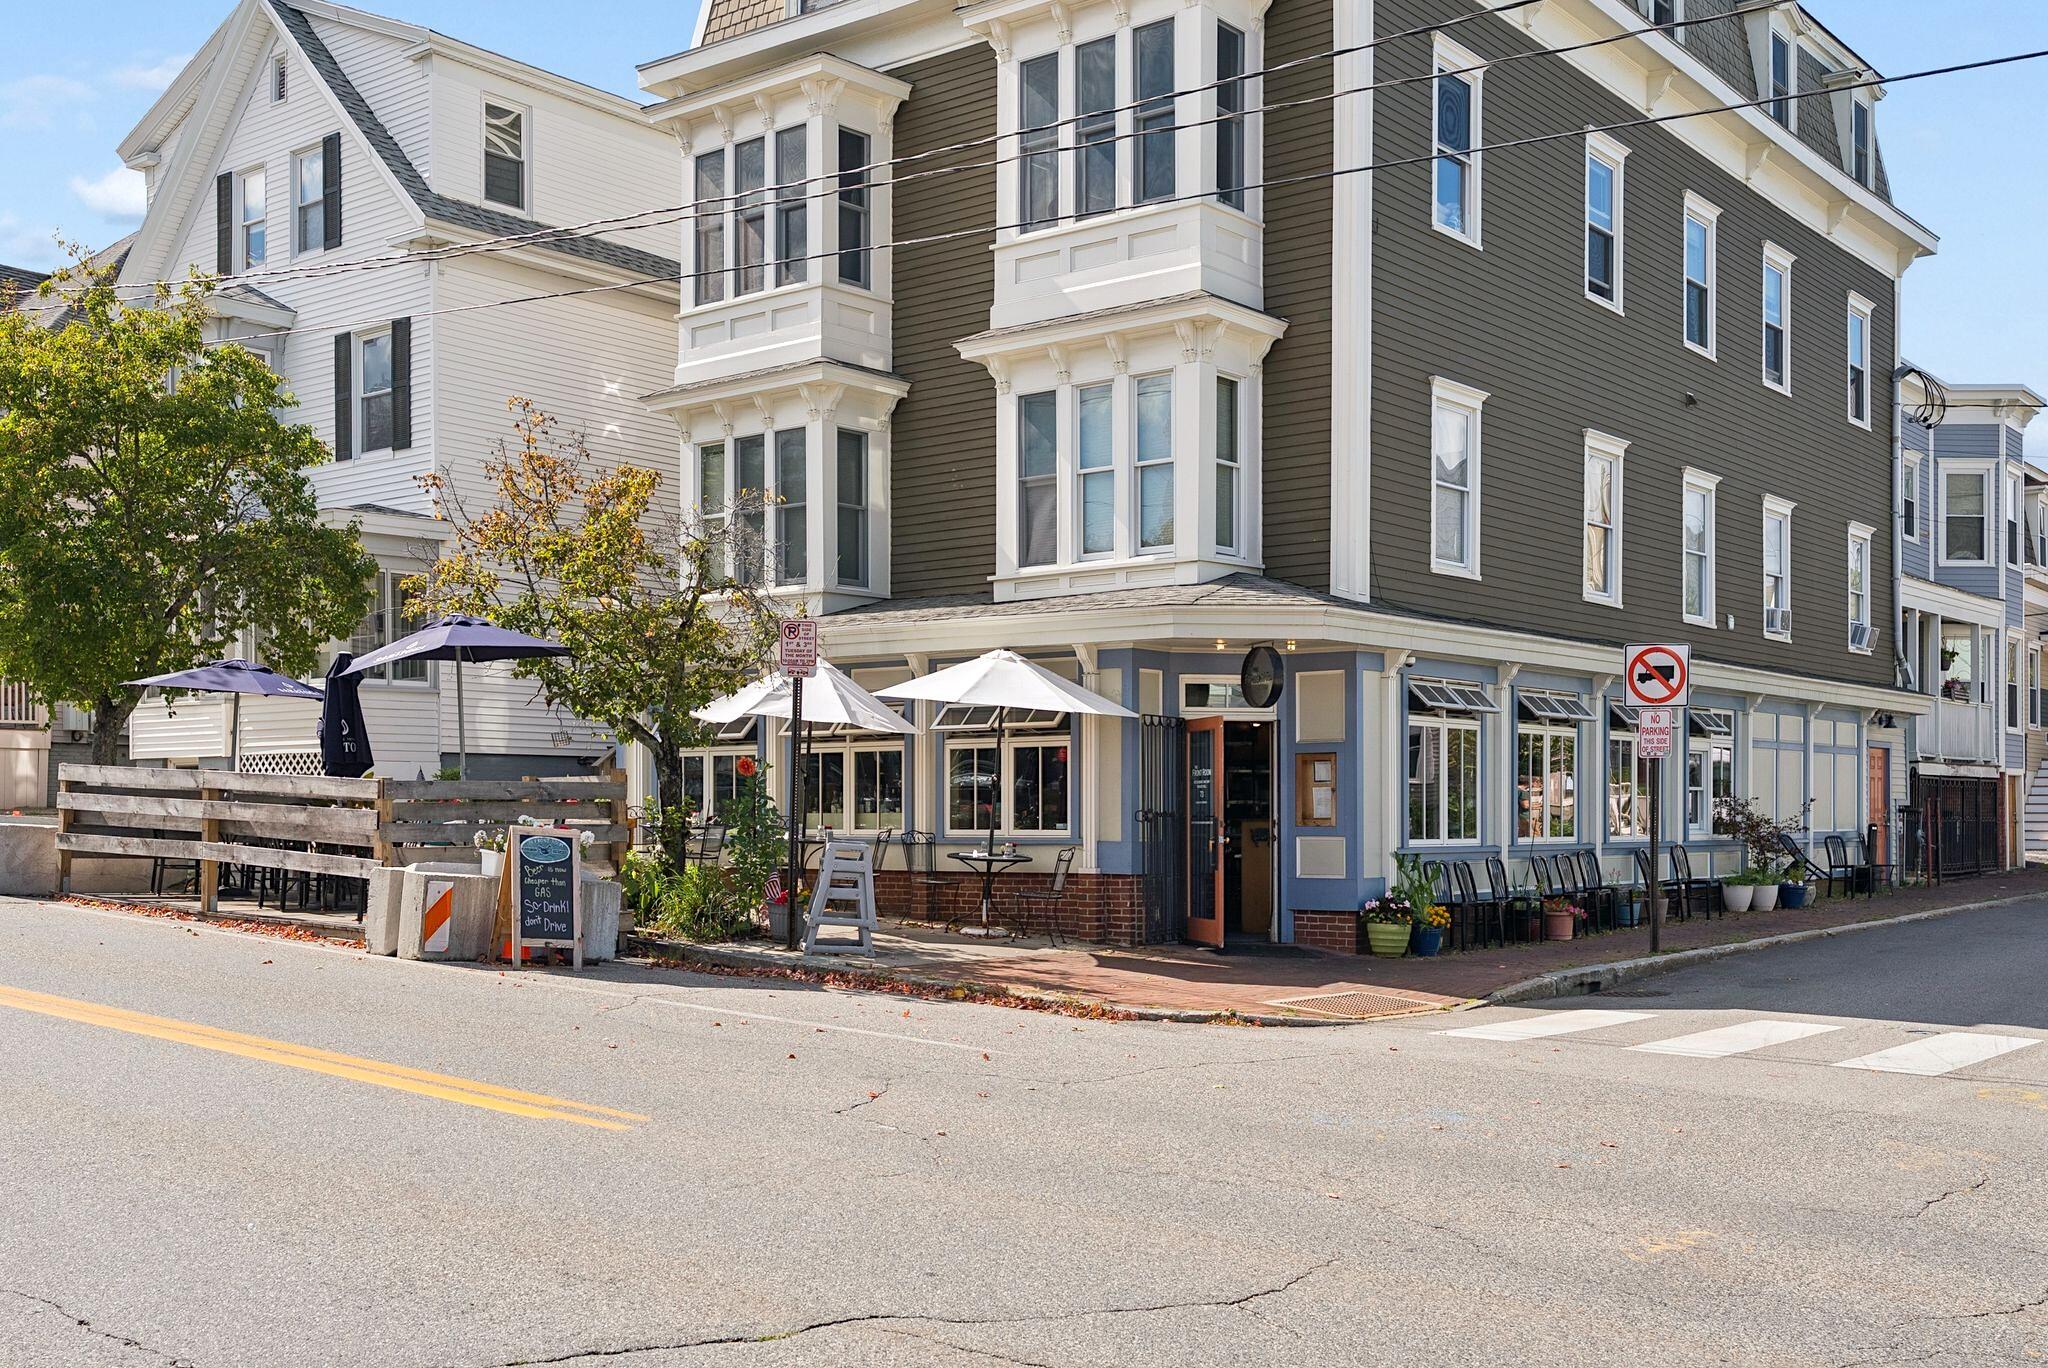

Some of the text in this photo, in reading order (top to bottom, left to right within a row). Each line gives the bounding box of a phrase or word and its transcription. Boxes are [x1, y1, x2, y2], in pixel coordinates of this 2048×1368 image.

[1650, 714, 1661, 724] NO
[1641, 726, 1669, 736] PARKING
[1643, 737, 1668, 745] THIS SIDE
[1641, 745, 1669, 753] OF STREET
[523, 864, 544, 877] Beer
[550, 877, 567, 886] than
[534, 887, 552, 898] GAS
[523, 898, 542, 913] So
[543, 917, 568, 932] Drive
